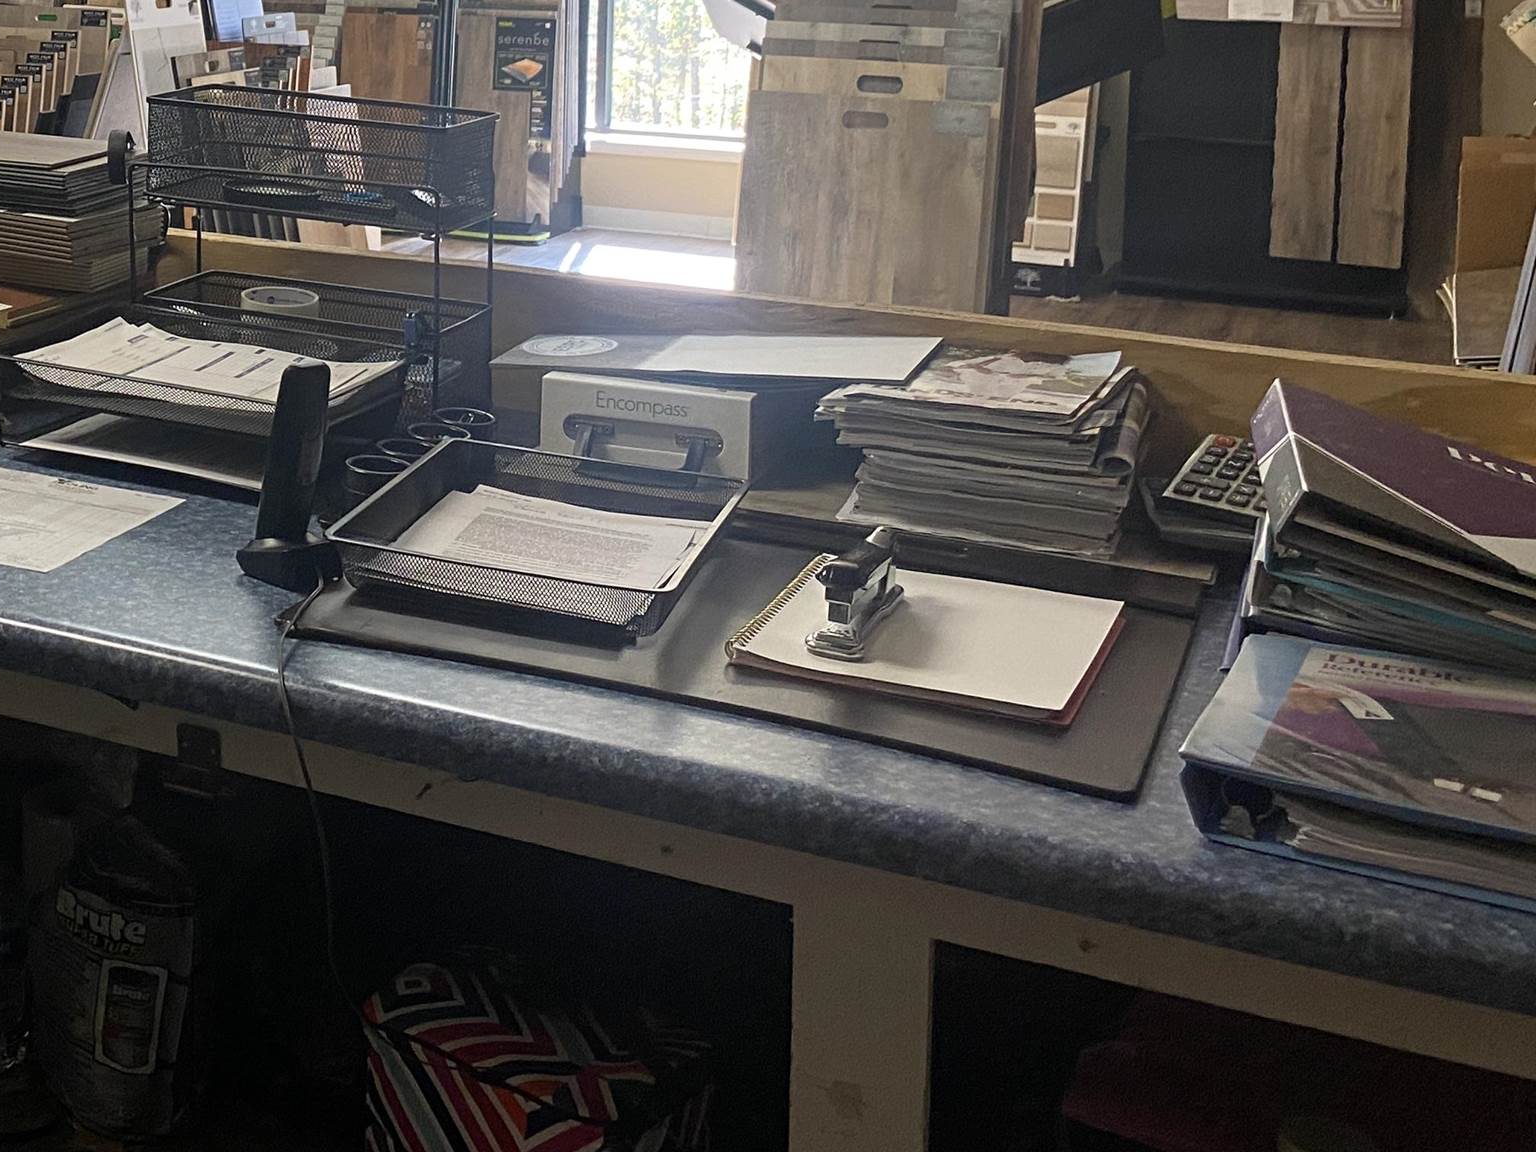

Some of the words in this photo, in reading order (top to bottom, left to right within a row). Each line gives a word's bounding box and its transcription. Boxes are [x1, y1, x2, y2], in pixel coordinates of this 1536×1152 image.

[497, 32, 550, 47] serenbe
[595, 389, 689, 419] Encompass
[55, 886, 148, 945] Brute
